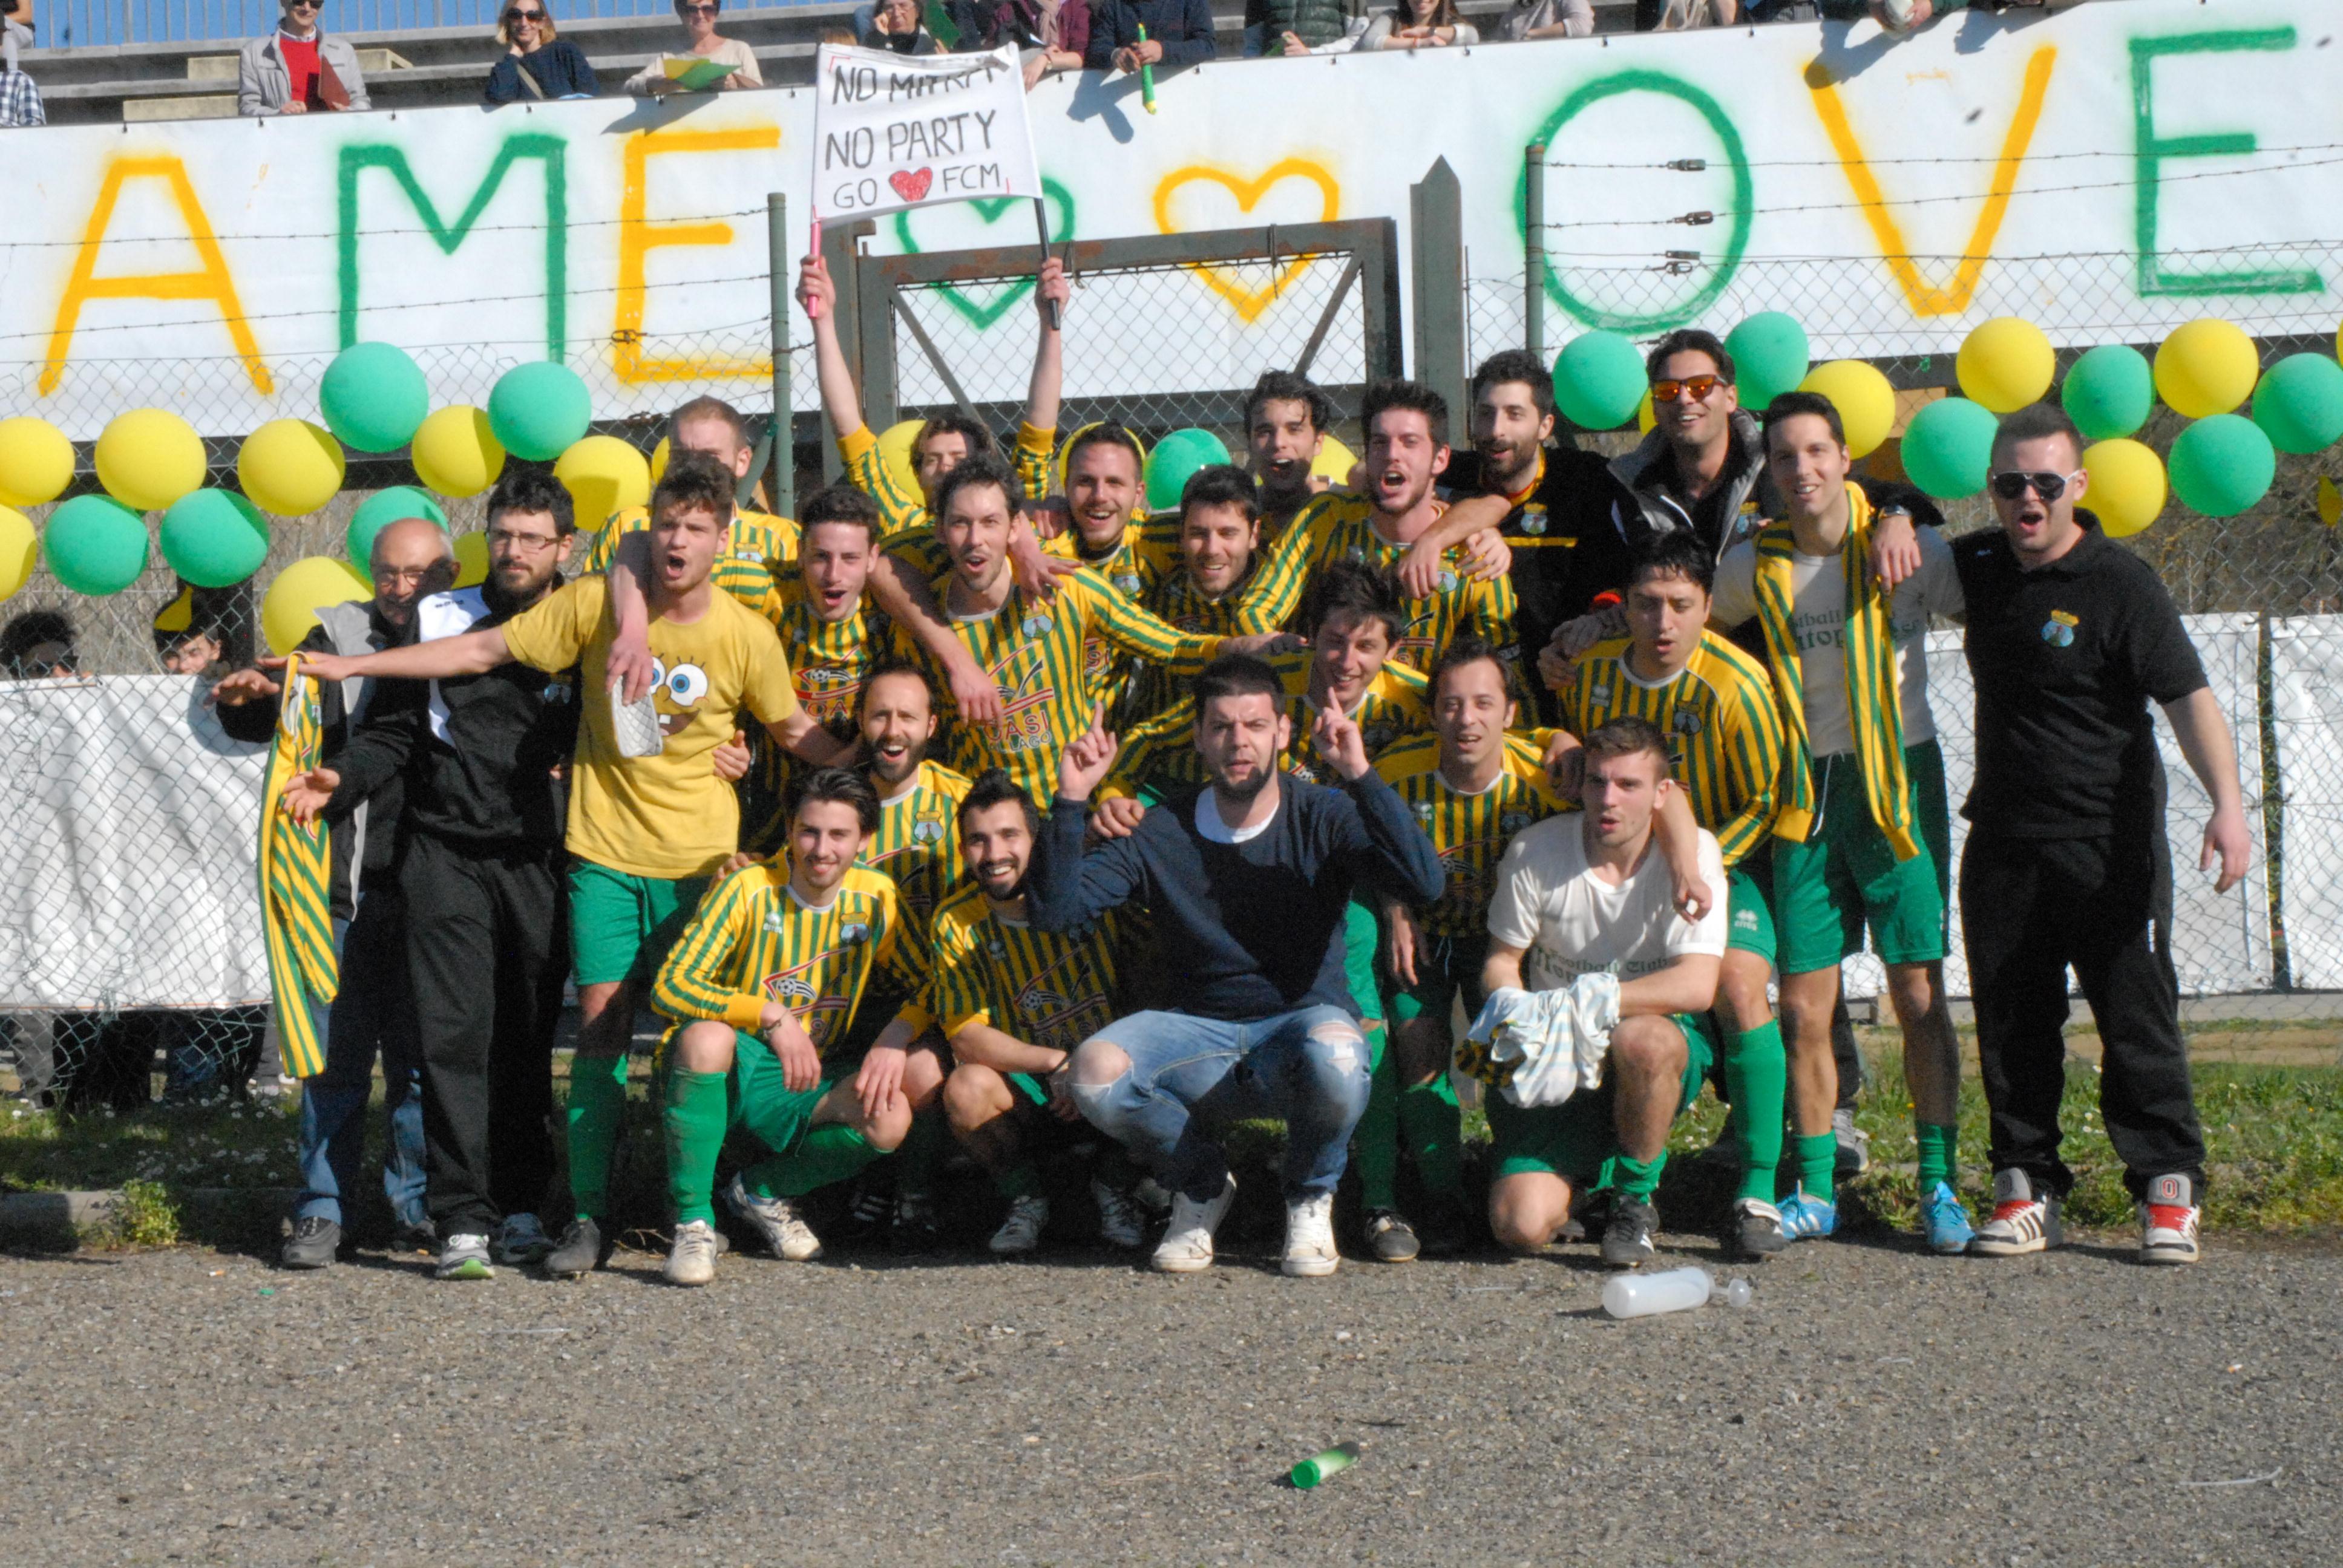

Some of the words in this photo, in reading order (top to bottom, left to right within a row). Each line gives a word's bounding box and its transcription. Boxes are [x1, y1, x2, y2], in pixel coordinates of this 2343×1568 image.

[833, 65, 877, 104] NO
[826, 127, 874, 170] NO
[888, 109, 996, 162] PARTY
[38, 127, 782, 396] AME
[1515, 25, 2325, 332] OVE
[834, 178, 877, 208] GO
[943, 163, 1000, 192] FCM
